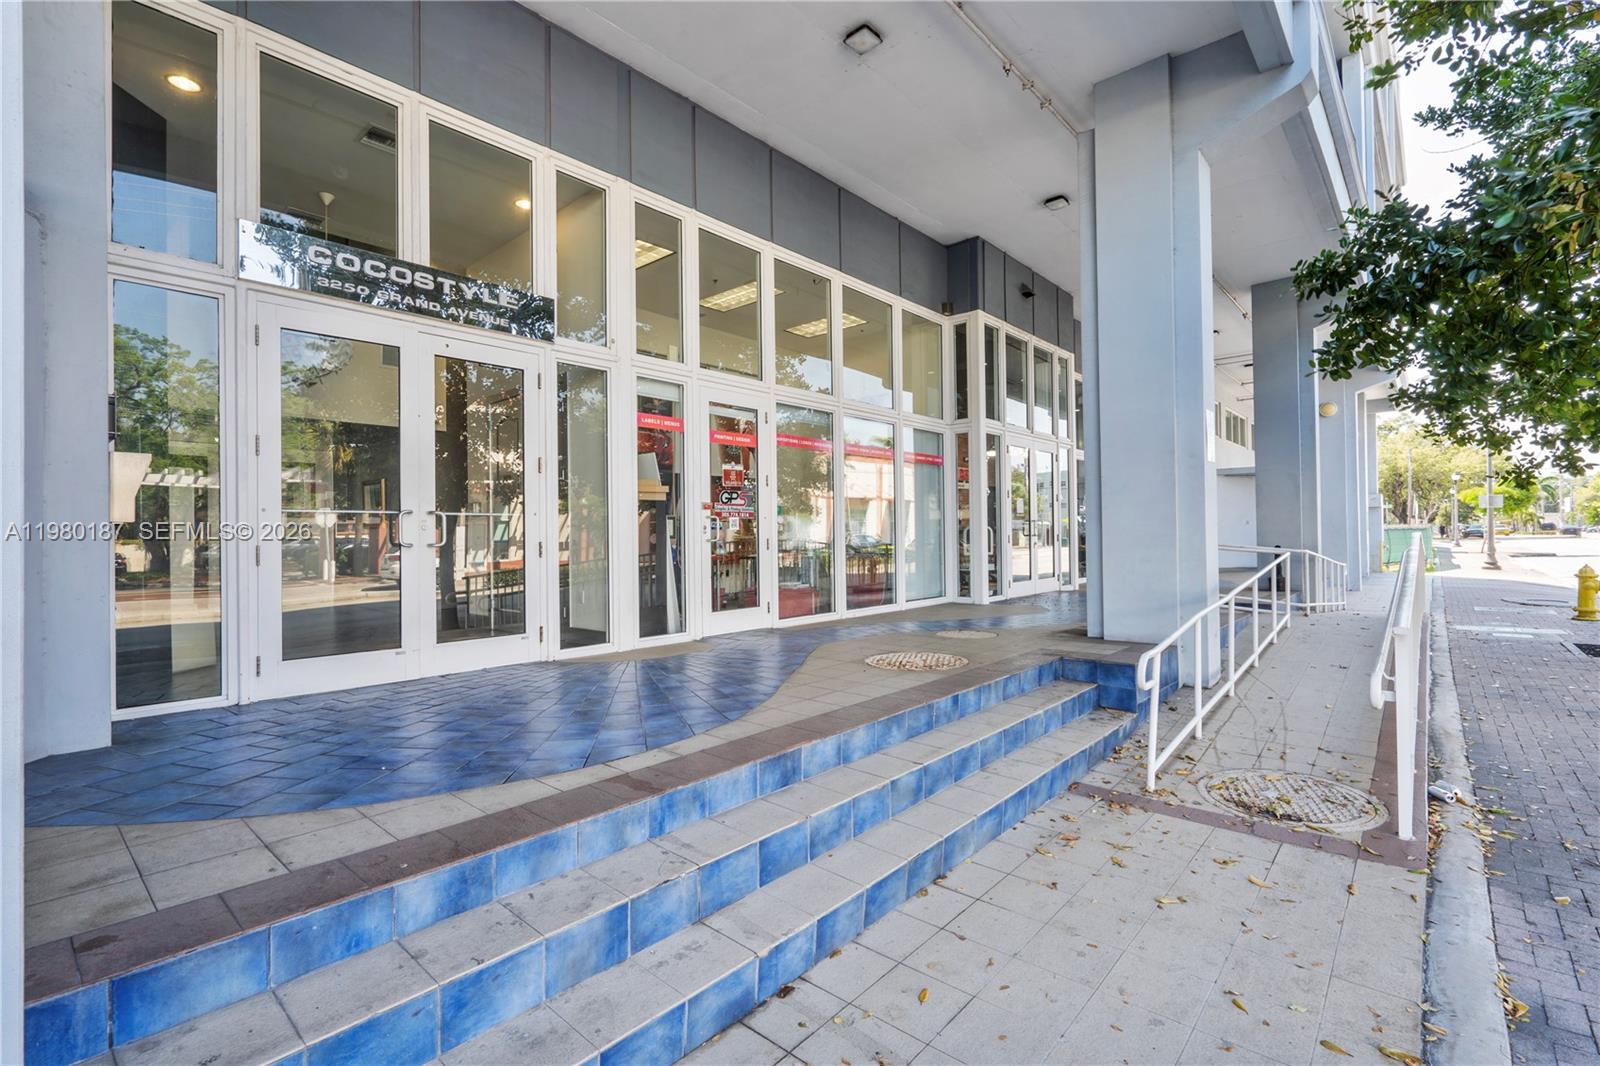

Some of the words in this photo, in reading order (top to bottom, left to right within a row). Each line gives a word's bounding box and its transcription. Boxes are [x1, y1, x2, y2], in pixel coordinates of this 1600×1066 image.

[308, 245, 520, 309] COCOSTYLE
[317, 277, 369, 296] 3250
[377, 290, 441, 313] GRAND
[447, 307, 510, 327] AVENUE
[641, 417, 660, 425] LABELS
[720, 491, 752, 506] GPS
